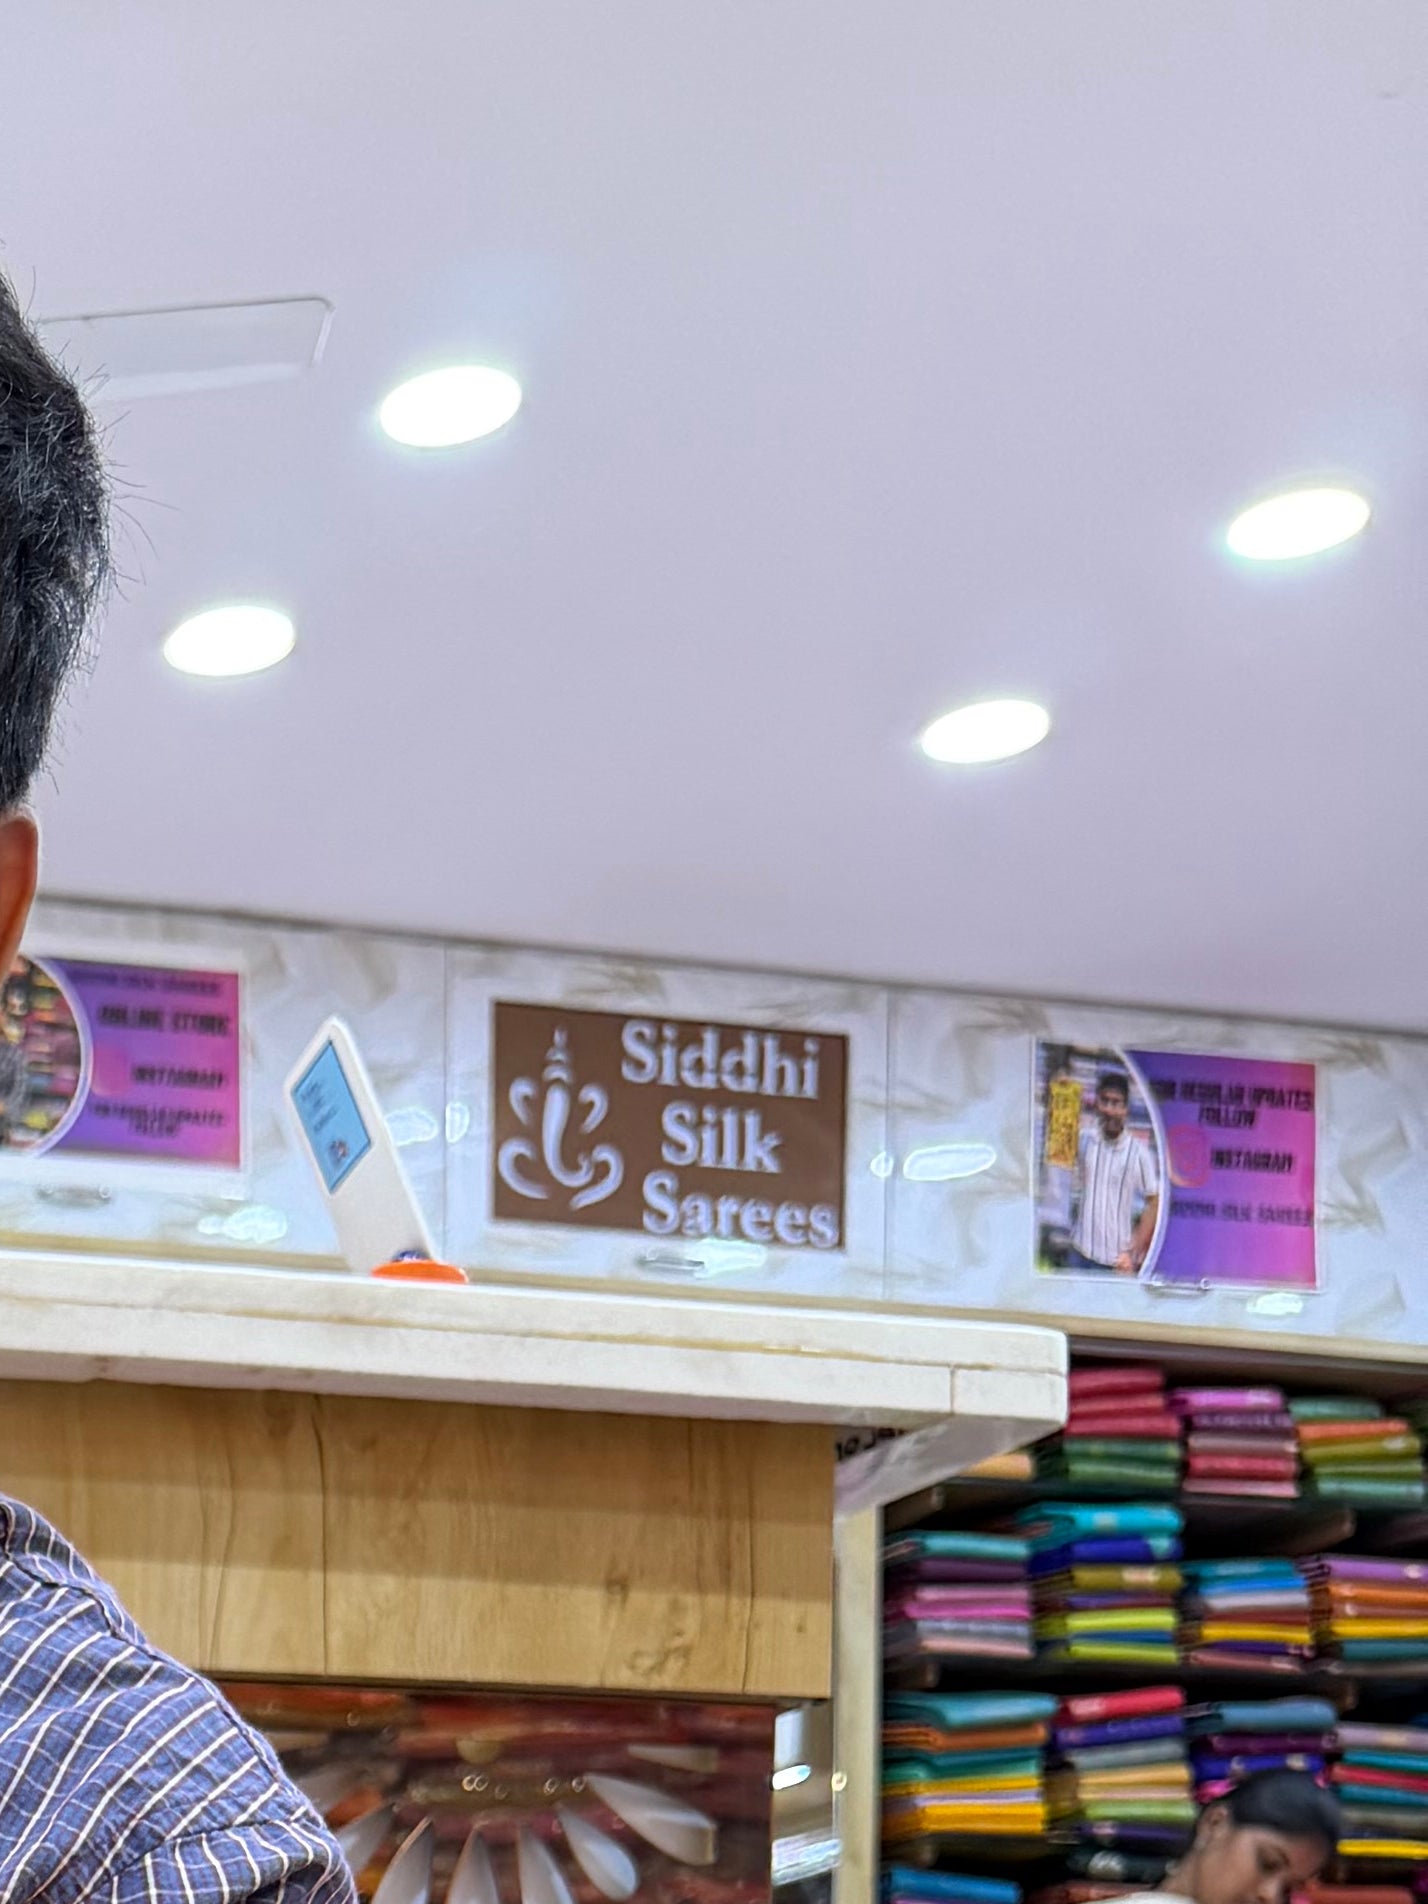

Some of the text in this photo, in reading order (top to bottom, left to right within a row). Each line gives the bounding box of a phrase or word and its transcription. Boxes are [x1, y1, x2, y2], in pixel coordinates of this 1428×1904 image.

[620, 1019, 820, 1099] Siddhi
[661, 1100, 784, 1174] Silk
[1199, 1106, 1257, 1128] FOLLOW
[642, 1169, 840, 1249] Sarees
